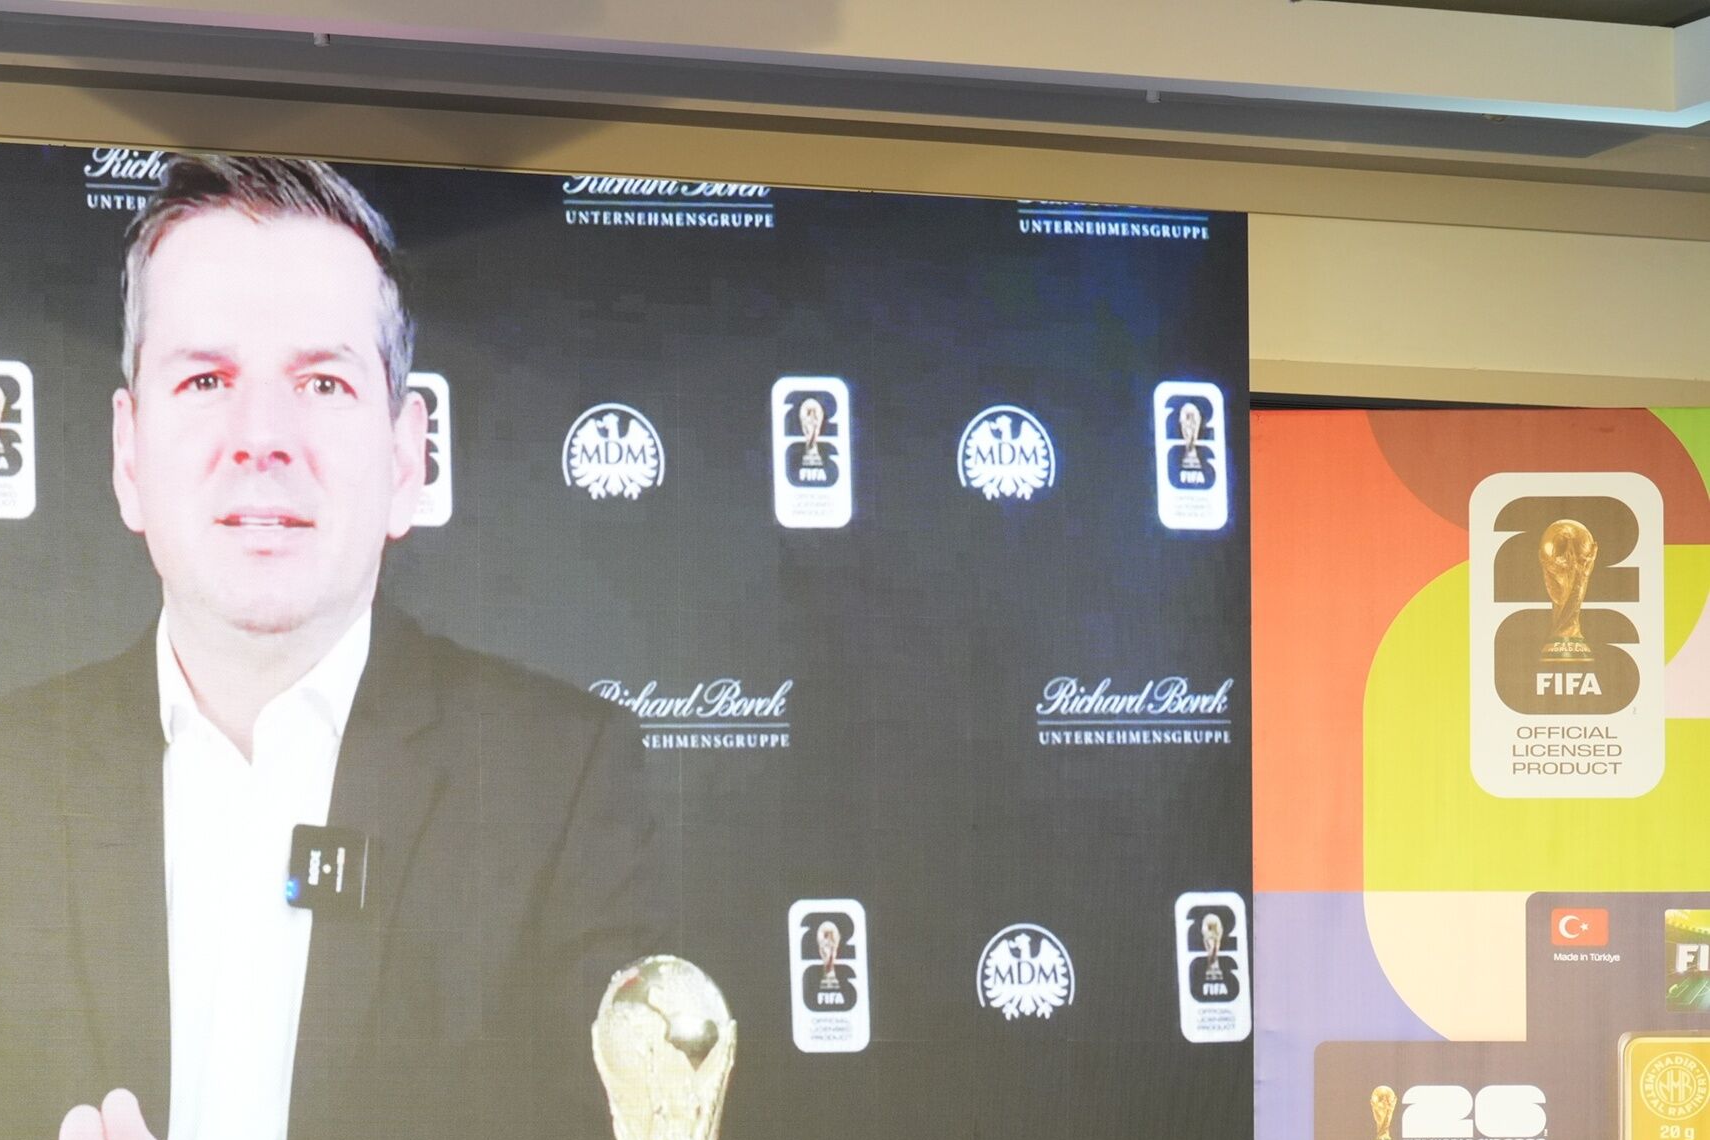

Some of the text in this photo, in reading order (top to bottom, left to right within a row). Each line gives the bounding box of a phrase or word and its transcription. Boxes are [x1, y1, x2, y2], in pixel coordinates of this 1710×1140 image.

[565, 210, 774, 228] UNTERNEHMENSGRUPPE
[1019, 219, 1210, 240] UNTERNEHMENSGRUPPE
[580, 441, 647, 464] MDM
[975, 442, 1039, 465] MDM
[799, 468, 827, 481] FIFA
[1536, 673, 1602, 695] FIFA
[696, 678, 794, 718] Borek
[1036, 676, 1234, 715] Richard Borek
[1039, 730, 1231, 745] UNTERNEHMENSGRUPPE
[1516, 726, 1618, 739] OFFICIAL
[1512, 744, 1622, 757] LICENSED
[1512, 762, 1622, 775] PRODUCT
[1554, 952, 1621, 963] Made in Türkiye
[994, 960, 1059, 985] MDM
[1203, 983, 1228, 996] FIFA
[817, 992, 845, 1005] FIFA
[1660, 1125, 1695, 1140] 20 g
